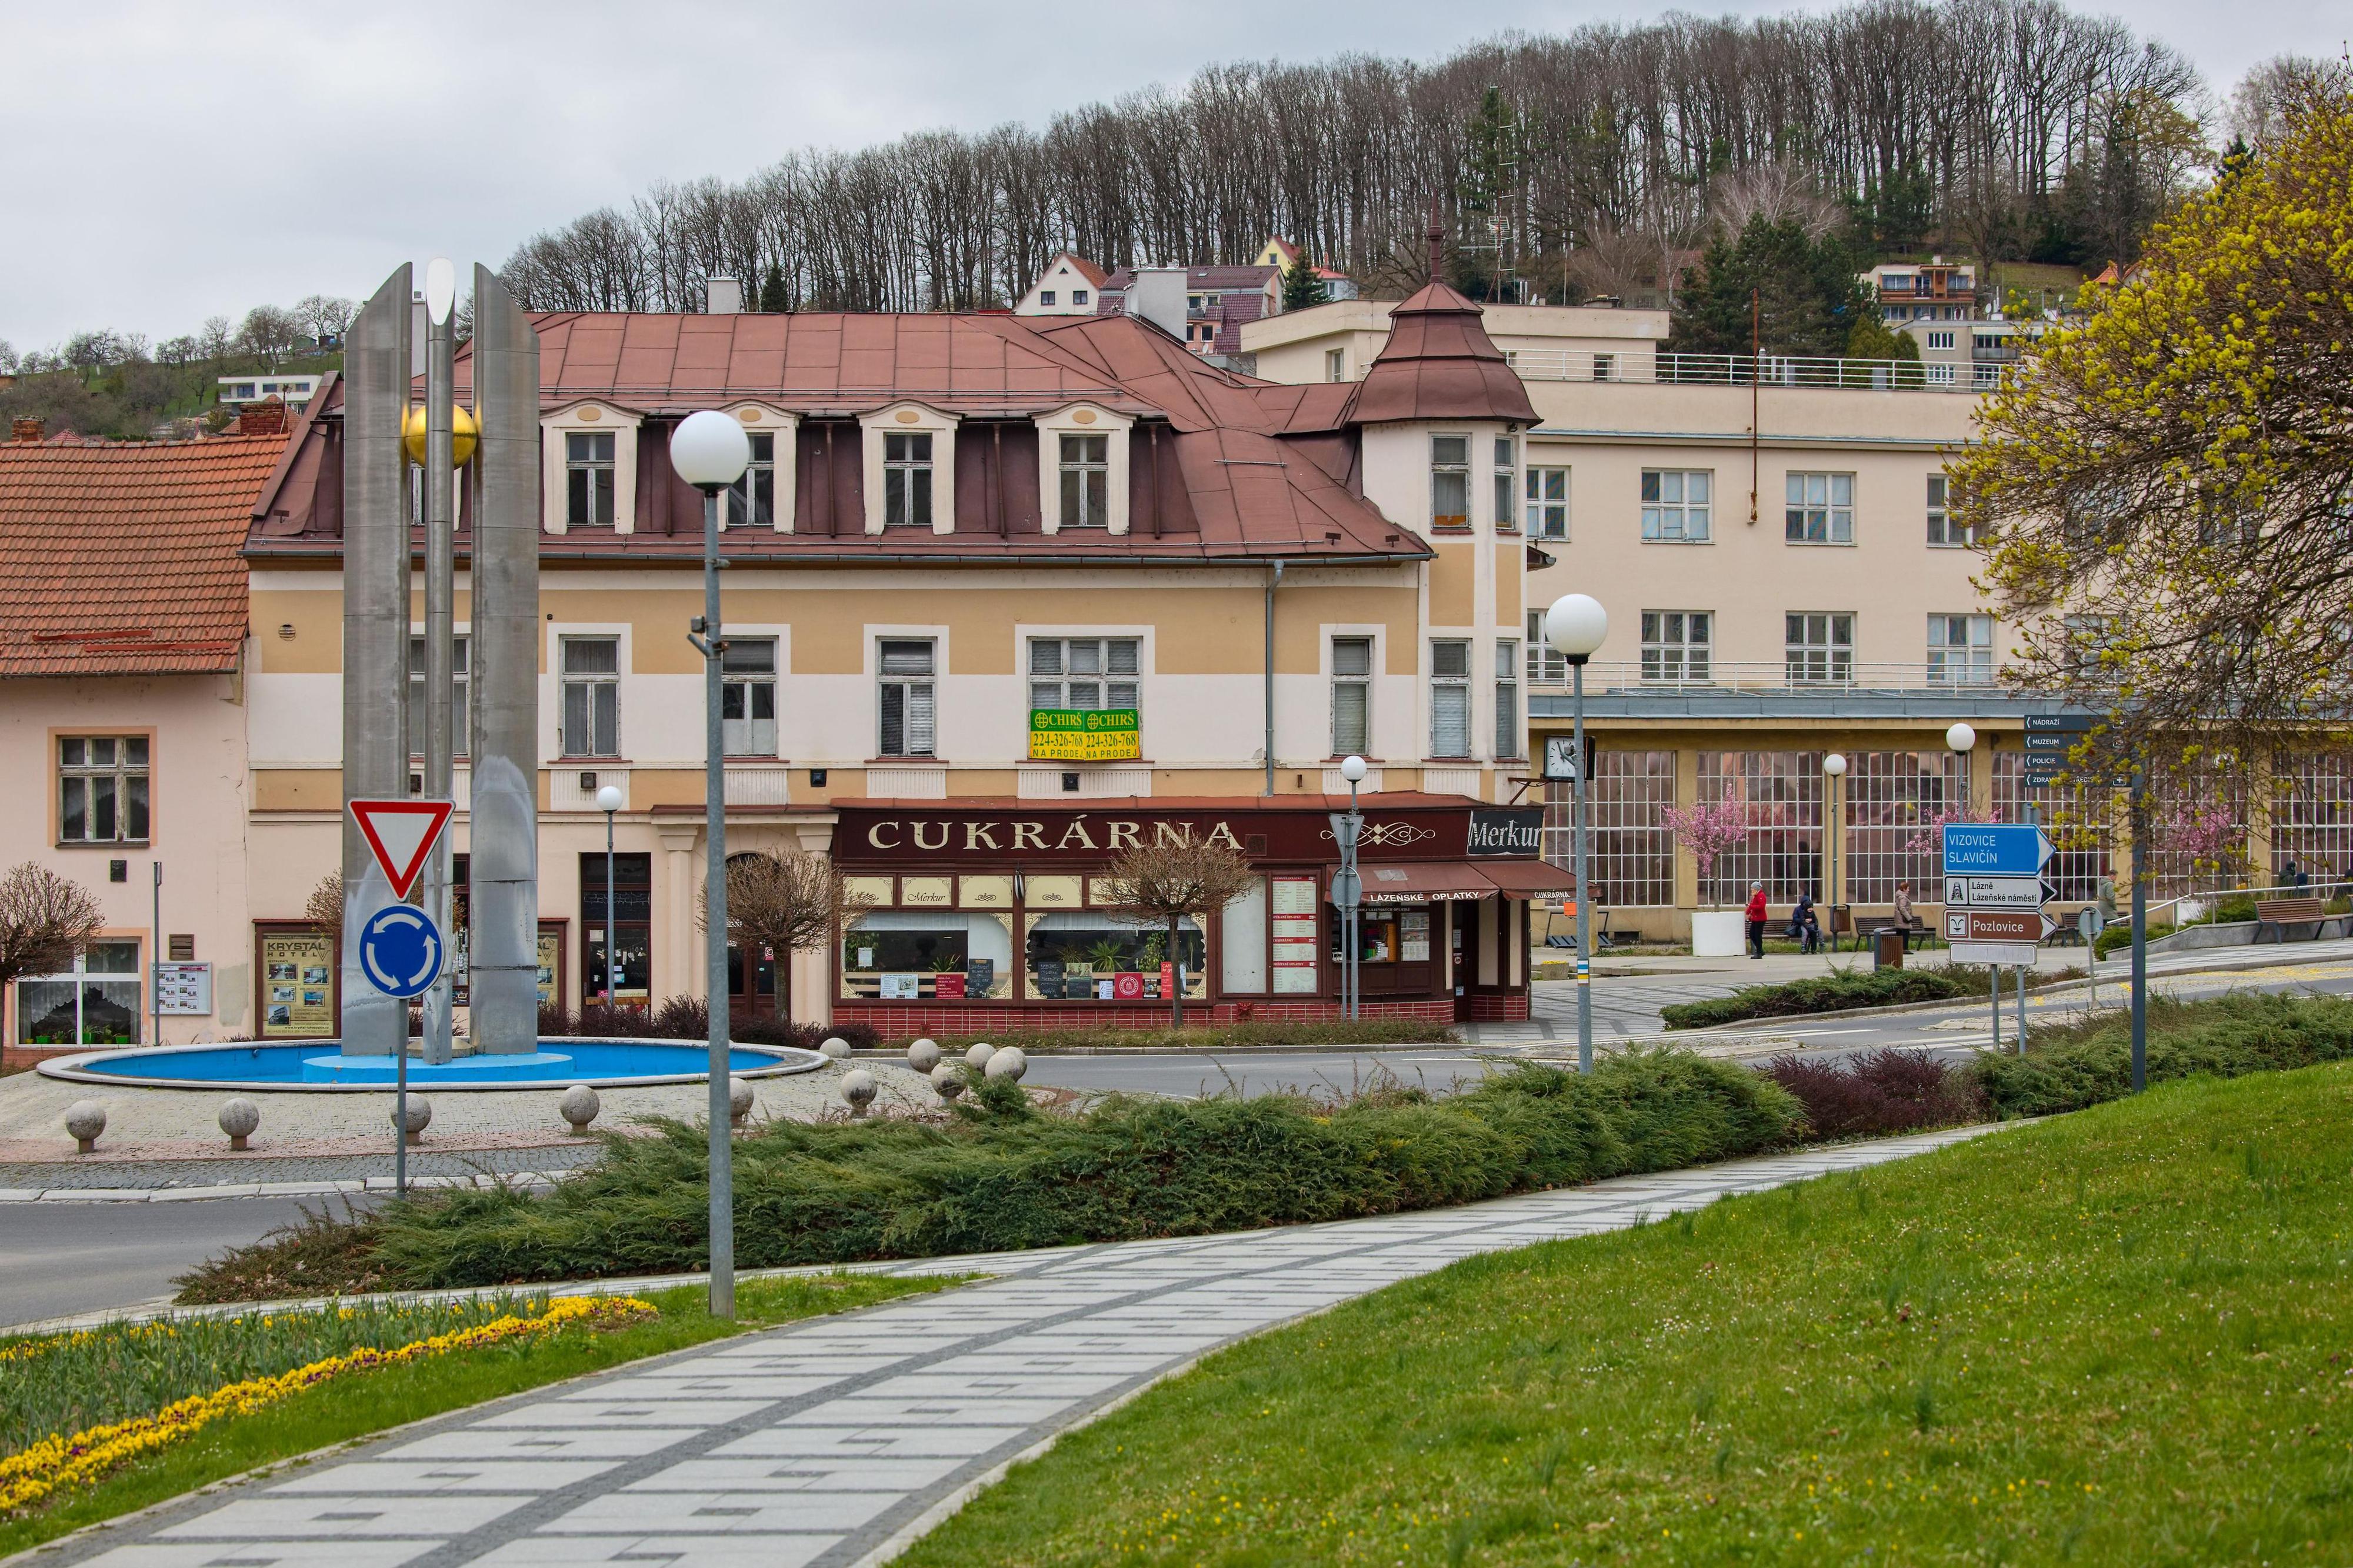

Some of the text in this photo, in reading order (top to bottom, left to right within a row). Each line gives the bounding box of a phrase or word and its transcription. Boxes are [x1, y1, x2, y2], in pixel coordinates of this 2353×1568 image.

[1049, 712, 1082, 726] CHIRŠ
[1099, 712, 1134, 726] CHIRŠ
[1034, 733, 1083, 747] 224-326-768
[1086, 733, 1136, 748] 224-326-768
[1051, 749, 1083, 758] PRODEJ
[1101, 749, 1136, 758] PRODEJ
[868, 815, 1244, 850] CUKRÁRNA
[1468, 819, 1542, 847] Merkur
[1949, 835, 1996, 846] VIZOVICE
[1949, 849, 1997, 863] SLAVIČÍN
[1972, 882, 1993, 890] Lázně
[908, 892, 945, 902] Merkur
[1371, 891, 1479, 902] LÁZEŇSKÉ OPLATKY
[1534, 889, 1570, 899] CUKRÁRNA
[1972, 893, 2005, 902] Lázeňské
[1973, 920, 2024, 932] Pozlovice
